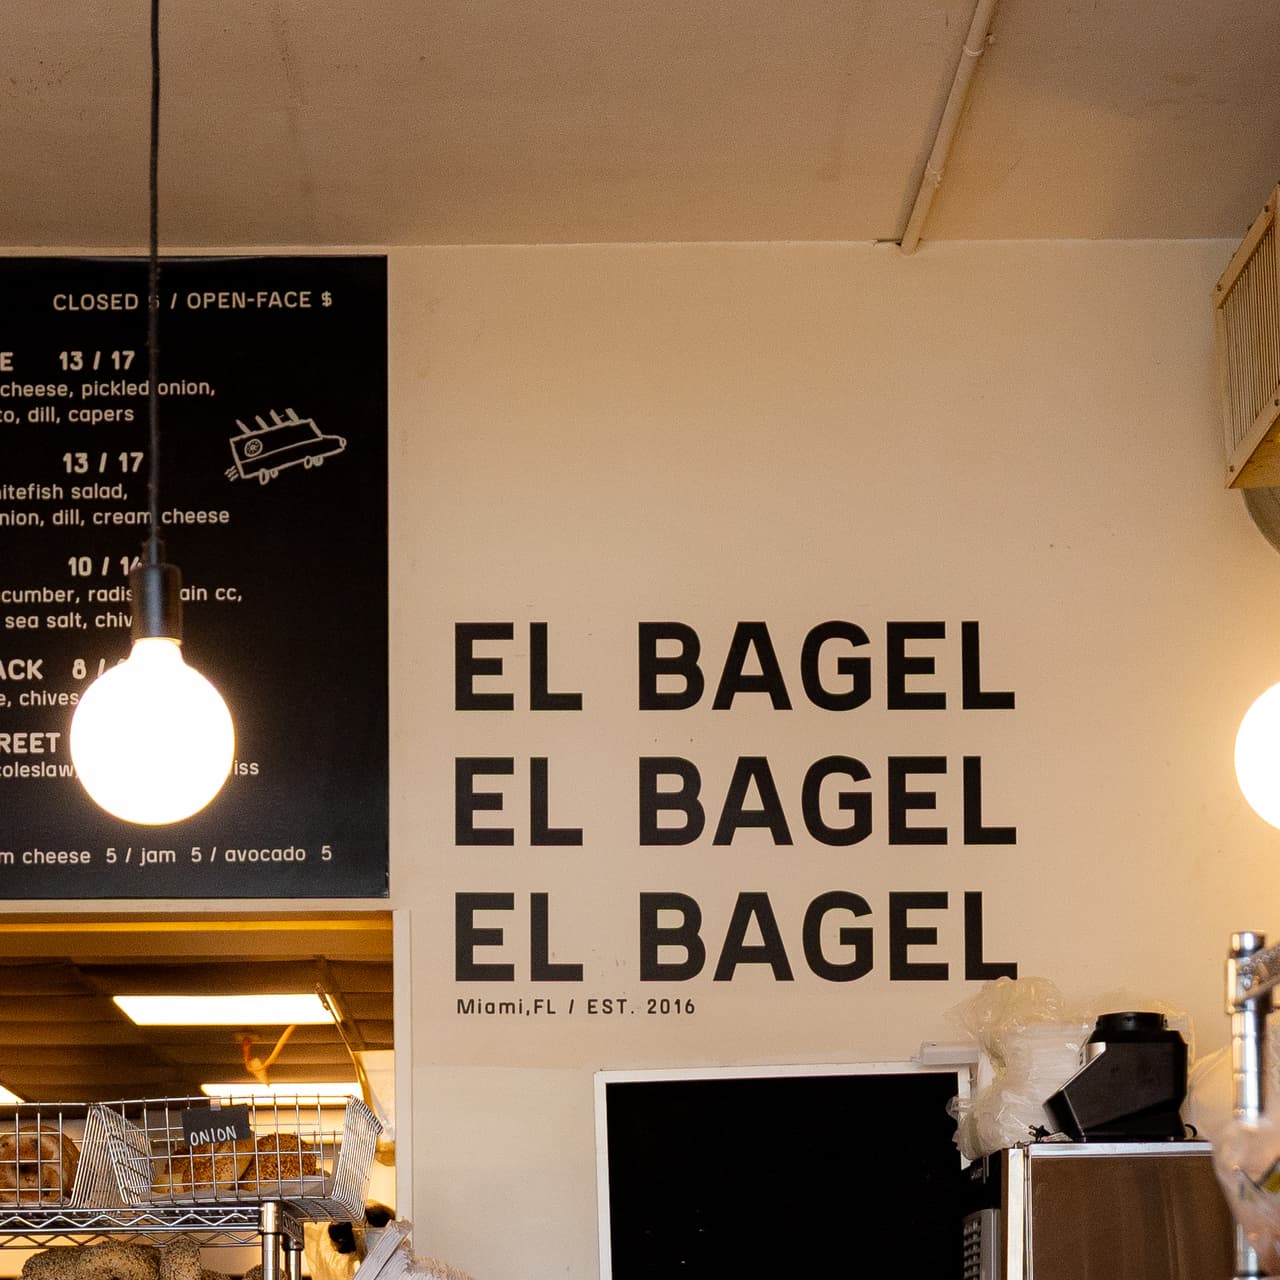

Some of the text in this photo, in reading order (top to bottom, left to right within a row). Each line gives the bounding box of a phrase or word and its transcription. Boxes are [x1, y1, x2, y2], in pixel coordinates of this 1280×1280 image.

[52, 290, 333, 312] CLOSED OPEN-FACE $
[58, 350, 84, 371] 13
[111, 350, 136, 371] 17
[62, 452, 89, 474] 13
[118, 451, 144, 473] 17
[70, 482, 128, 501] salad,
[67, 556, 93, 577] 10
[72, 659, 86, 679] 8
[455, 620, 1016, 711] EL BAGEL
[455, 755, 1017, 847] EL BAGEL
[455, 890, 1018, 982] EL BAGEL
[456, 998, 696, 1017] Miami,FL EST. 2016
[190, 1125, 237, 1146] ONION
